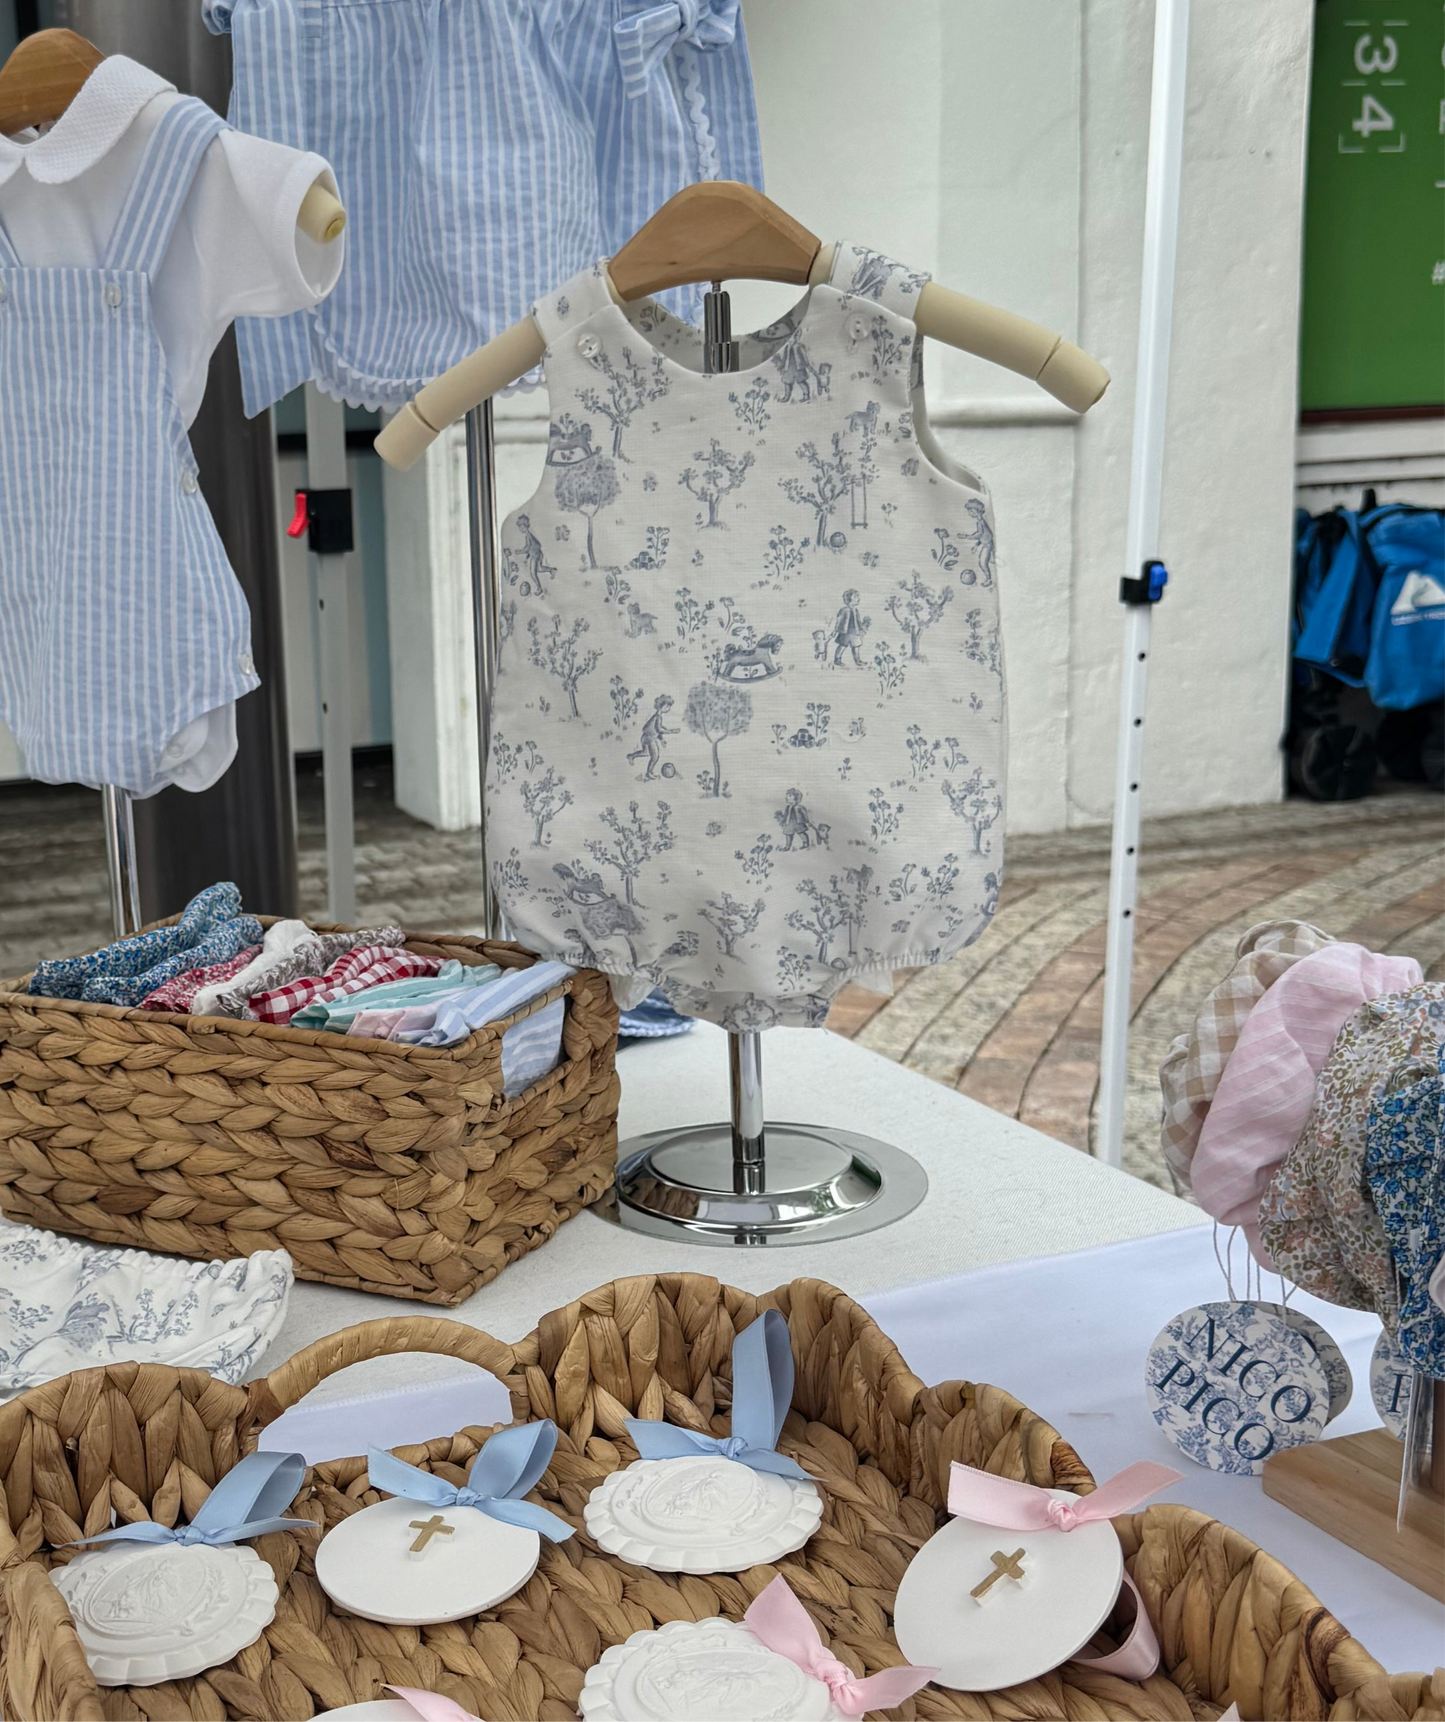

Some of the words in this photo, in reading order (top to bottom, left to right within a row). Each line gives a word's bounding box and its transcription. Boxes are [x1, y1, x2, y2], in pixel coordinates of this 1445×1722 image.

[1353, 33, 1398, 75] 3
[1351, 93, 1395, 138] 4
[1184, 1316, 1312, 1424] NICO
[1154, 1355, 1275, 1461] PICO
